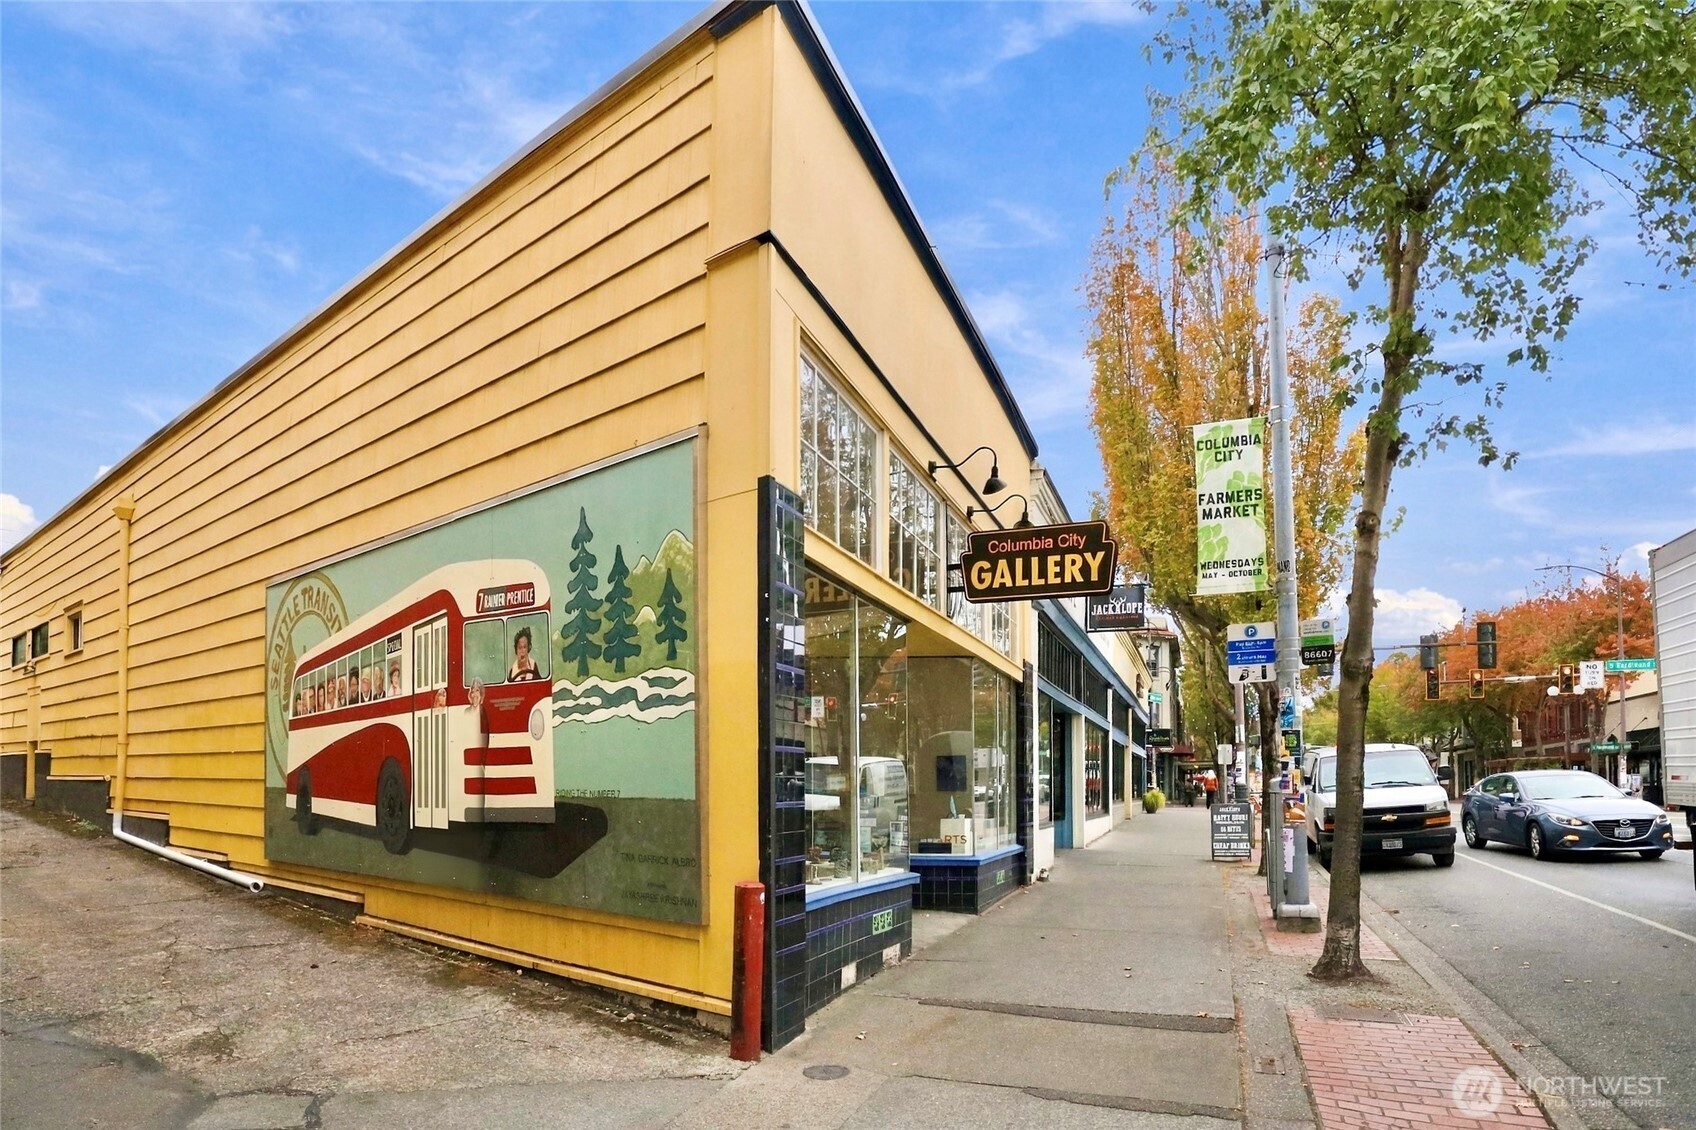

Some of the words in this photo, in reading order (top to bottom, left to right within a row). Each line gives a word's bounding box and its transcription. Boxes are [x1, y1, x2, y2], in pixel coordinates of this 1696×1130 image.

[1196, 433, 1262, 452] COLUMBIA
[1214, 449, 1243, 463] CITY
[1198, 488, 1263, 506] FARMERS
[1202, 503, 1259, 520] MARKET
[988, 536, 1053, 554] Columbia
[1058, 533, 1087, 549] City
[970, 551, 1105, 590] GALLERY
[1200, 557, 1264, 571] WEDNESDAYS
[1202, 571, 1218, 579] MAY
[1228, 568, 1262, 578] OCTOBER
[478, 592, 484, 612] 7
[506, 588, 534, 606] PRENTICE
[1091, 601, 1143, 616] JACKALOPE
[270, 595, 301, 691] SEATTLE
[1304, 650, 1332, 659] 86607
